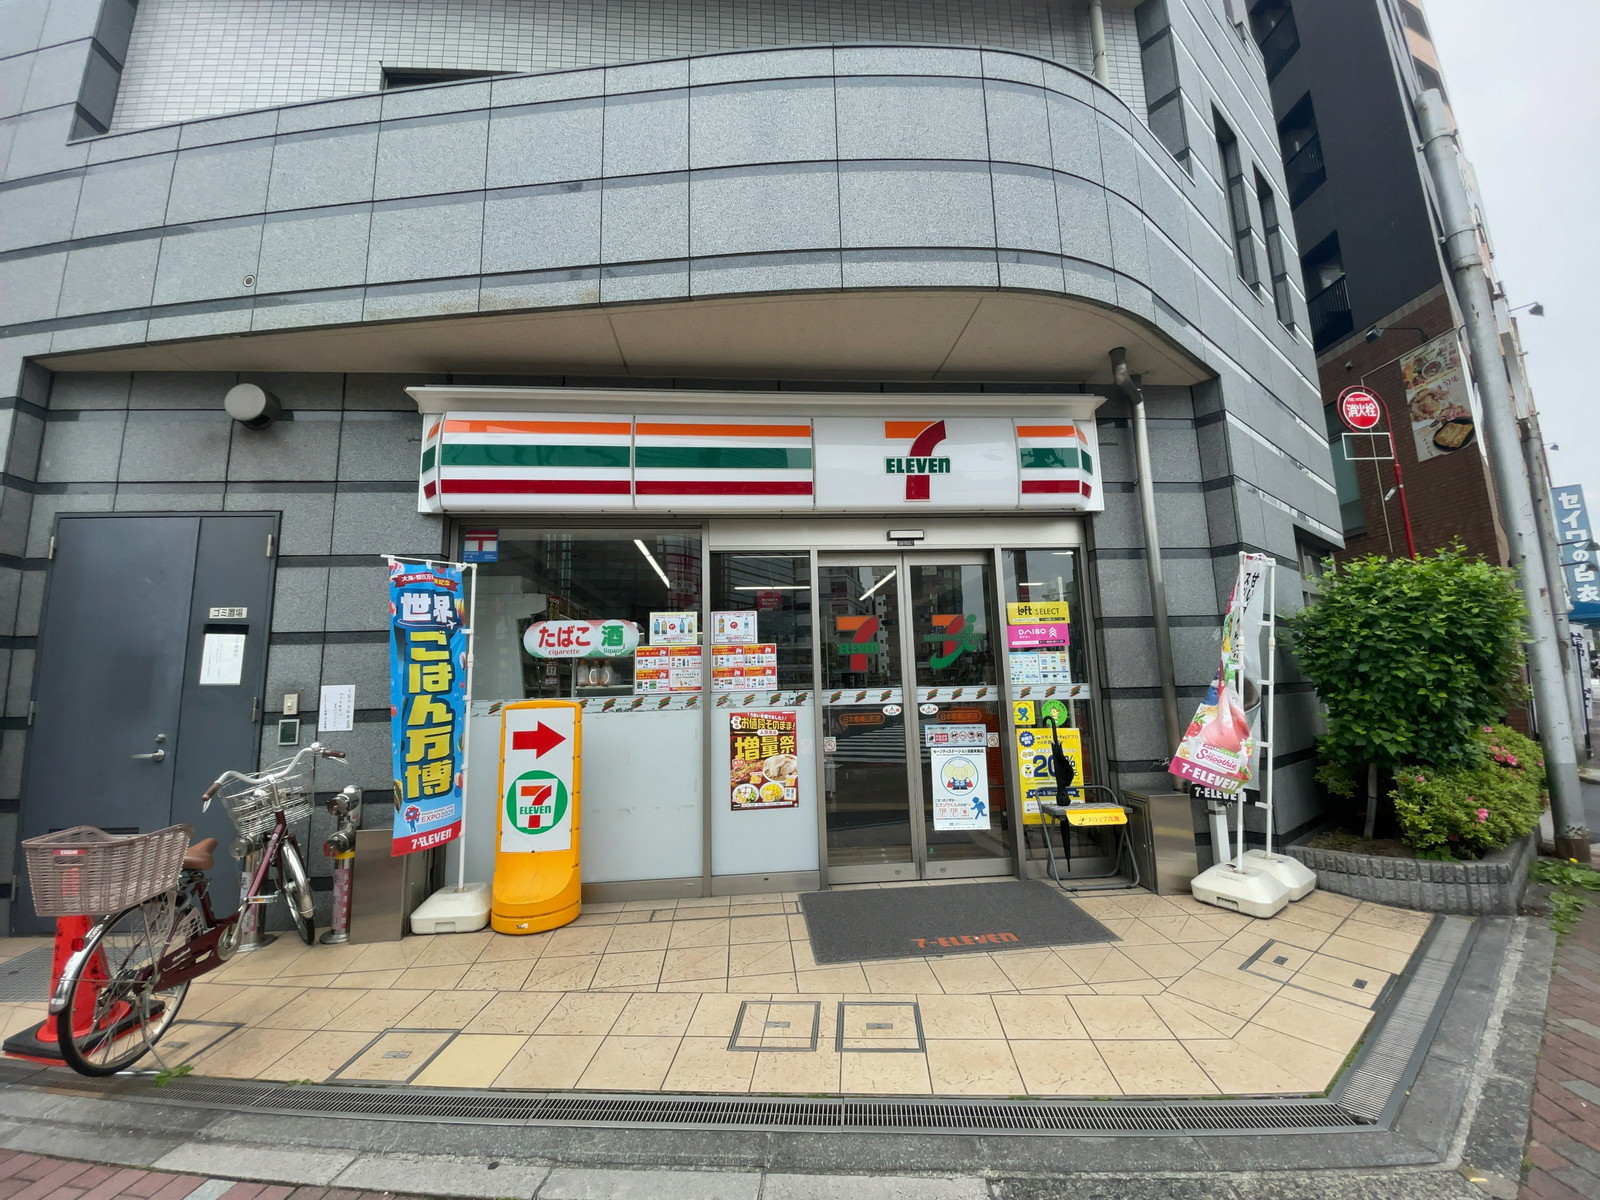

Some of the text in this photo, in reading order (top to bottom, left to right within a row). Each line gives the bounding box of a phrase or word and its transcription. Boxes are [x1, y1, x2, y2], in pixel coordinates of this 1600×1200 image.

[1346, 403, 1377, 417] 消火栓
[1558, 492, 1600, 602] セイワの白衣
[400, 592, 453, 623] 世界
[1035, 607, 1060, 615] SELECT
[538, 625, 591, 648] たばこ
[601, 625, 624, 647] 酒
[604, 647, 623, 655] liquor
[405, 630, 453, 799] ごはん万博
[734, 735, 795, 761] 増量祭
[1196, 748, 1238, 770] Smoothie
